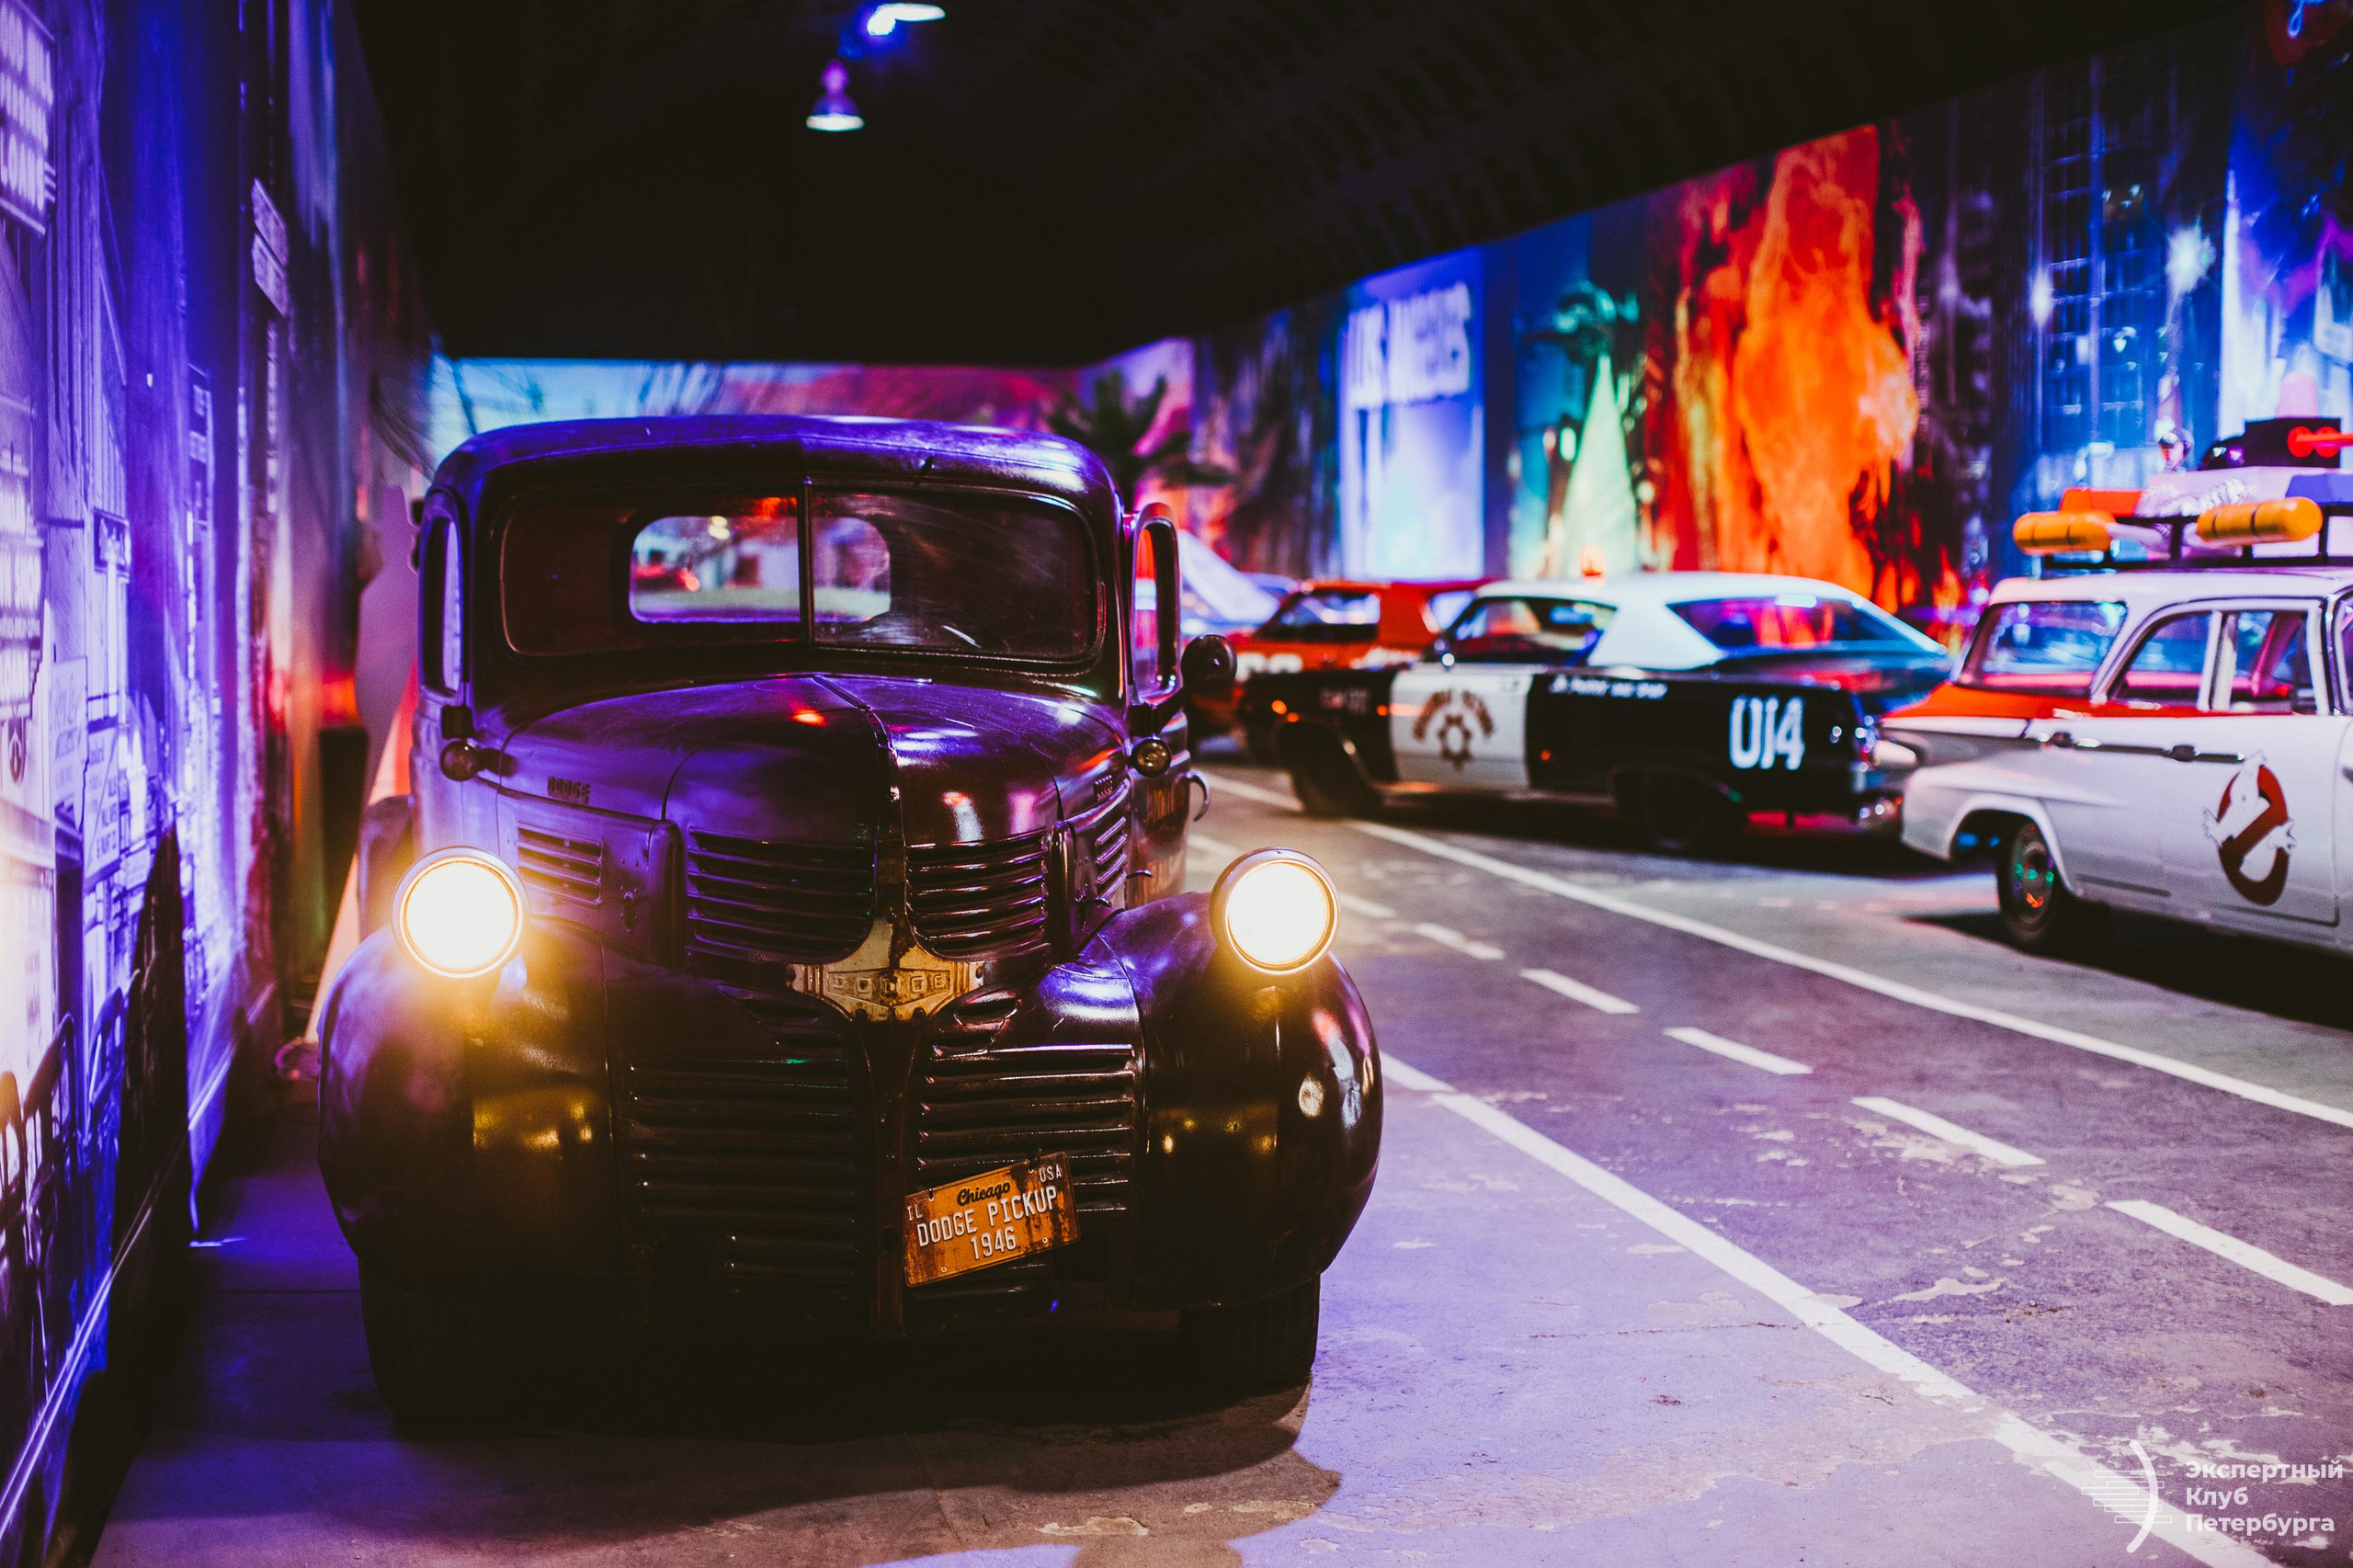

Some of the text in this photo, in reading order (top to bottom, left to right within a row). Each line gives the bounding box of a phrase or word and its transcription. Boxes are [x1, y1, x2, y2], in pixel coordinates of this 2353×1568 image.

[1039, 1164, 1063, 1183] USA
[956, 1181, 1011, 1207] Chicago
[906, 1205, 924, 1221] IL
[916, 1185, 1057, 1247] DODGE PICKUP
[971, 1225, 1017, 1261] 1946
